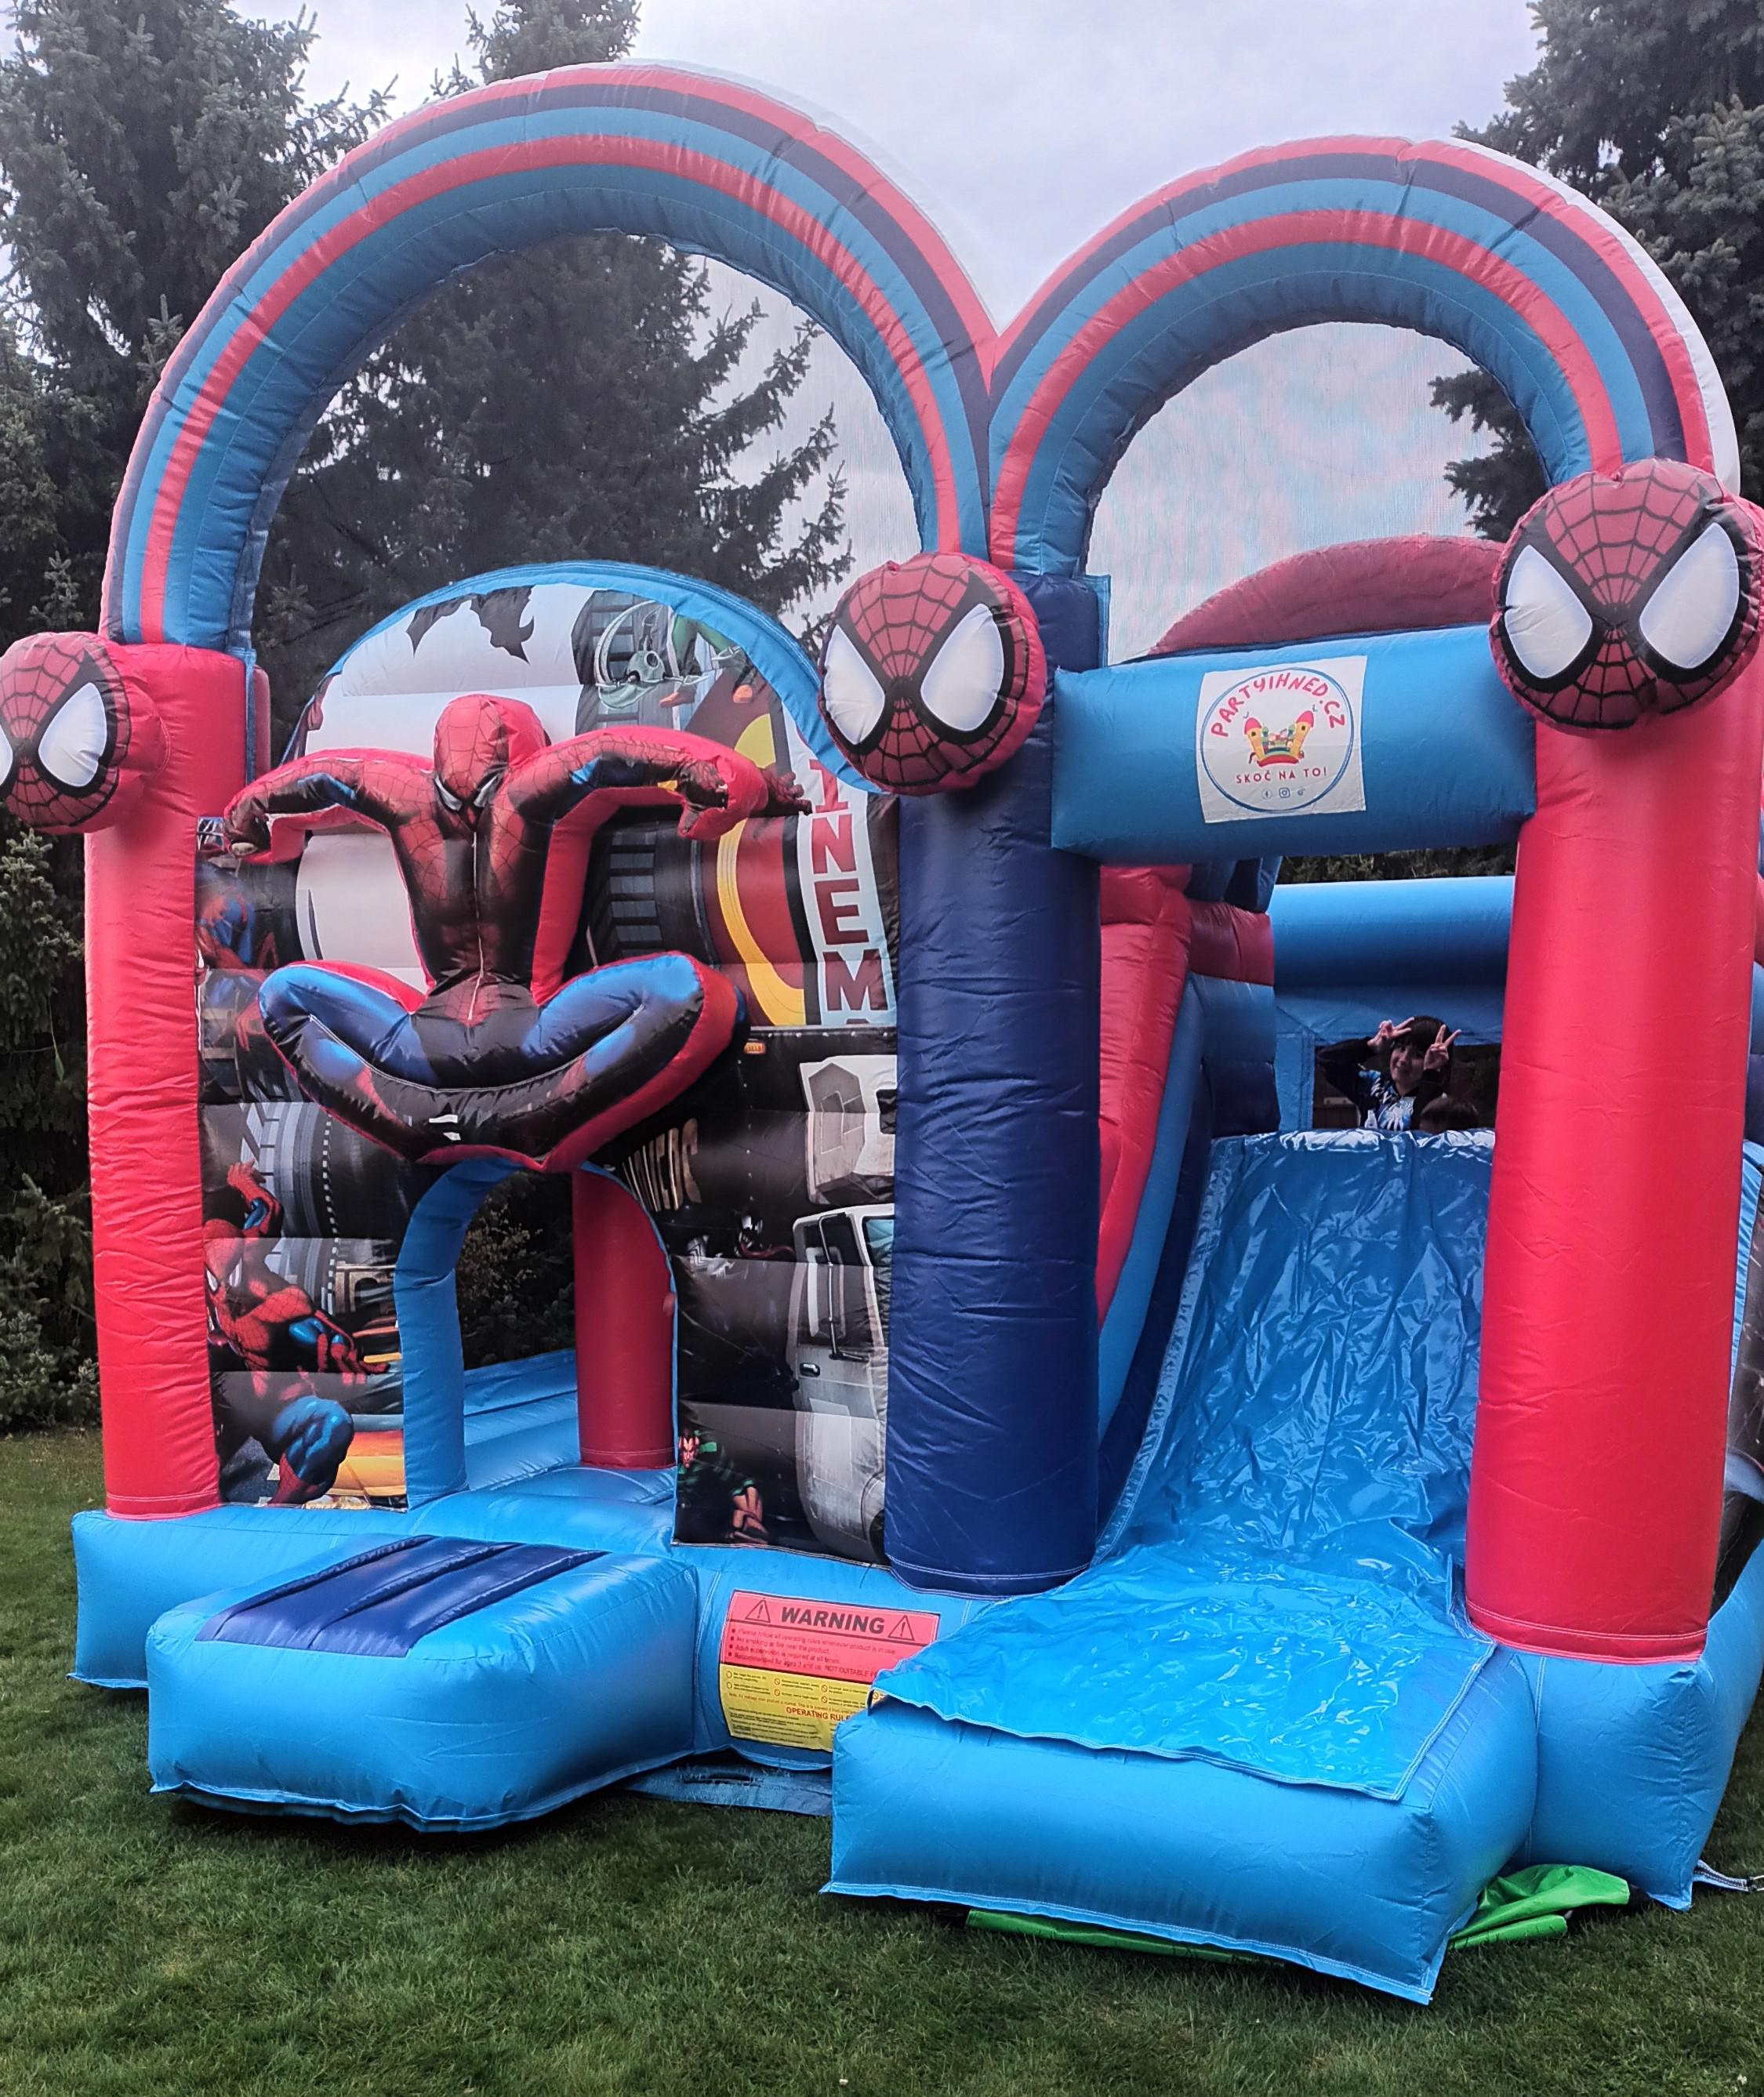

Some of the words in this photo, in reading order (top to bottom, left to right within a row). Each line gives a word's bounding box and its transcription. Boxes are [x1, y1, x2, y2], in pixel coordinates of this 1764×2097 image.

[1210, 673, 1345, 738] PARTYIHNED.CZ
[1236, 767, 1271, 784] SKOČ
[1279, 771, 1296, 781] NA
[1305, 767, 1327, 778] TO!
[809, 759, 888, 1024] INEM
[781, 1606, 884, 1634] WARNING
[786, 1706, 829, 1720] OPERATING
